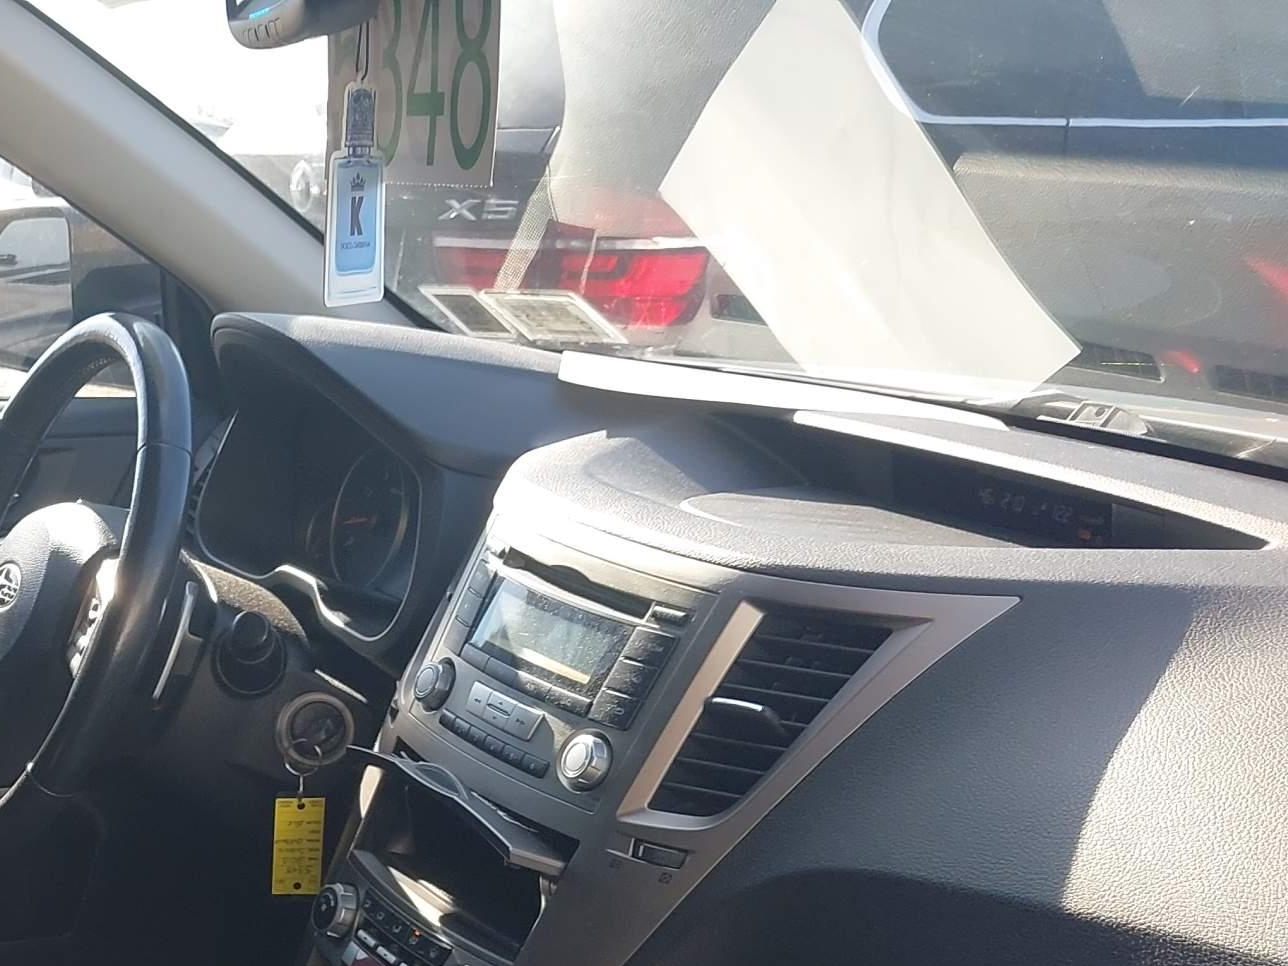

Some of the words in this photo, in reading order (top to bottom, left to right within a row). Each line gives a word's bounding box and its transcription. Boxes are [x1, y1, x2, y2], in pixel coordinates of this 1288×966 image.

[334, 0, 492, 170] 348
[349, 196, 365, 236] K
[438, 198, 519, 221] X5
